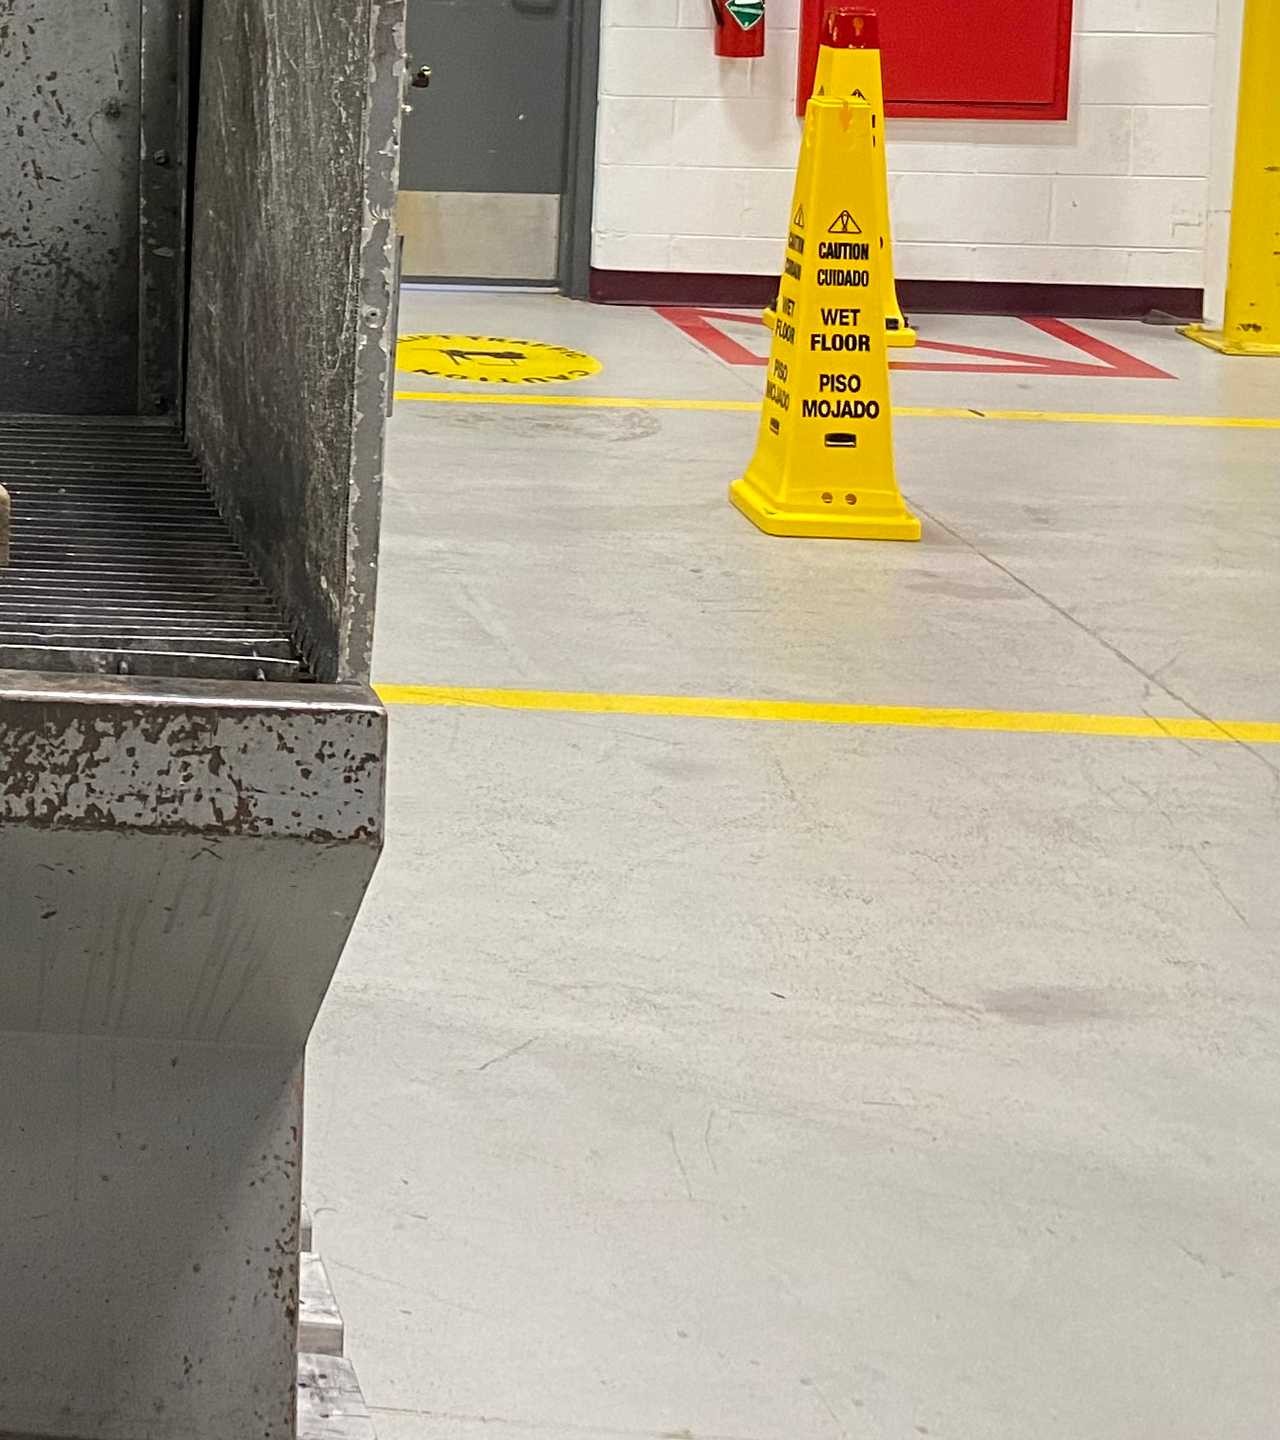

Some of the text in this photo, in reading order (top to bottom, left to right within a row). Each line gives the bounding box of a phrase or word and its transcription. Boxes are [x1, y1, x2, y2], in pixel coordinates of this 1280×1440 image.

[818, 242, 869, 261] CAUTION
[817, 269, 869, 287] CUIDADO
[820, 308, 861, 327] WET
[810, 333, 871, 352] FLOOR
[819, 374, 861, 392] PISO
[802, 400, 880, 419] MOJADO
